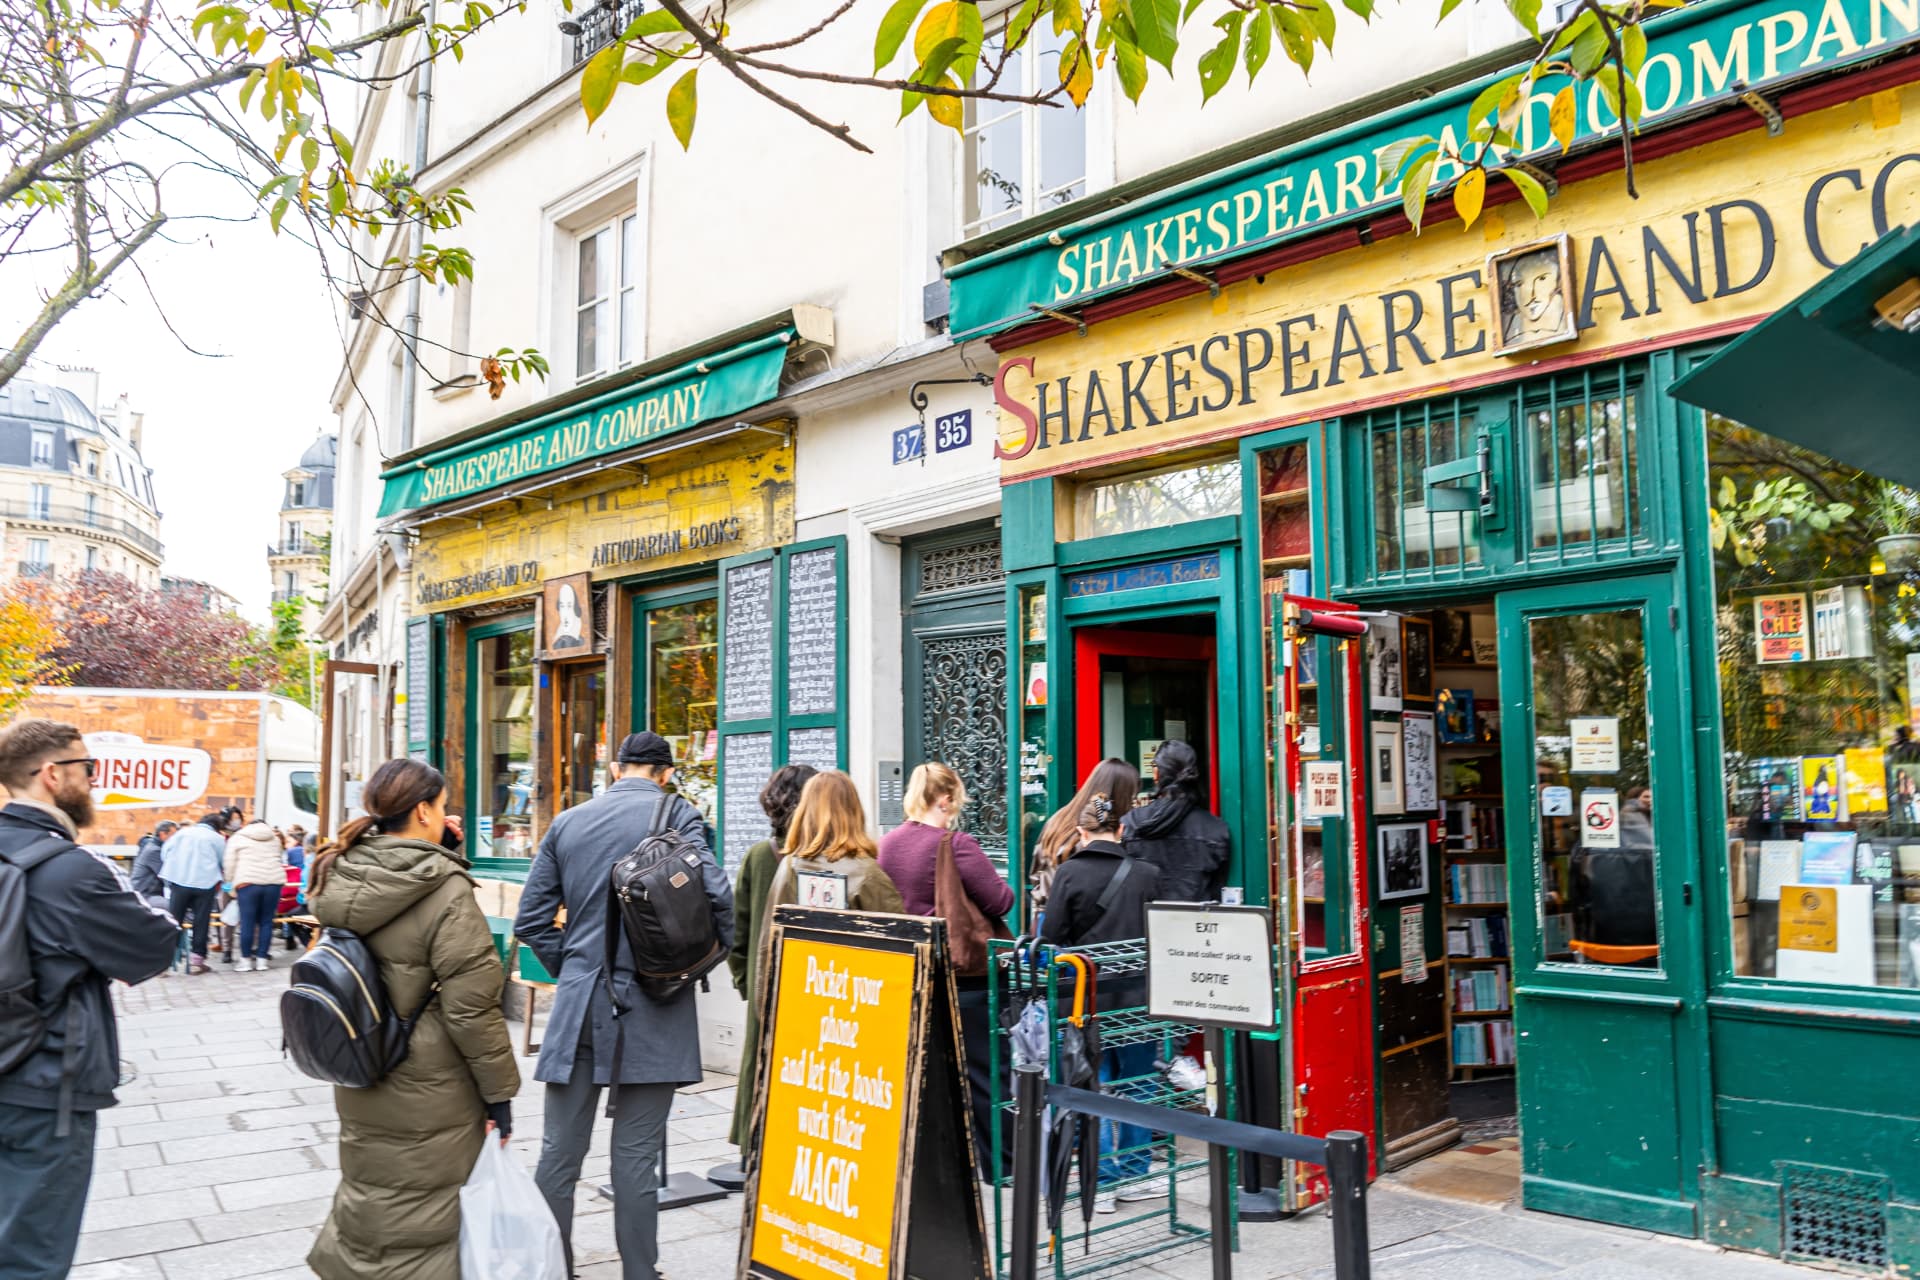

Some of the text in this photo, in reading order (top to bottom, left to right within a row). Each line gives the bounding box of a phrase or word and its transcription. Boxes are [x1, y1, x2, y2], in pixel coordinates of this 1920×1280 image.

[1054, 147, 1405, 300] SHAKESPEARE
[993, 269, 1487, 461] SHAKESPEARE
[1577, 199, 1776, 330] AND
[420, 380, 708, 502] SHAKESPEARE AND COMPANY
[896, 427, 921, 461] 37
[939, 415, 968, 448] 35
[591, 516, 740, 568] ANTIQUARIAN BOOKS
[1195, 922, 1219, 933] EXIT
[1190, 972, 1230, 985] SORTIE
[1243, 954, 1252, 962] up
[805, 954, 884, 1013] Pocket your
[1195, 1000, 1207, 1008] des
[1208, 1003, 1250, 1012] commandes
[817, 1004, 859, 1052] phone
[780, 1048, 893, 1111] and let the books
[798, 1099, 866, 1151] work their
